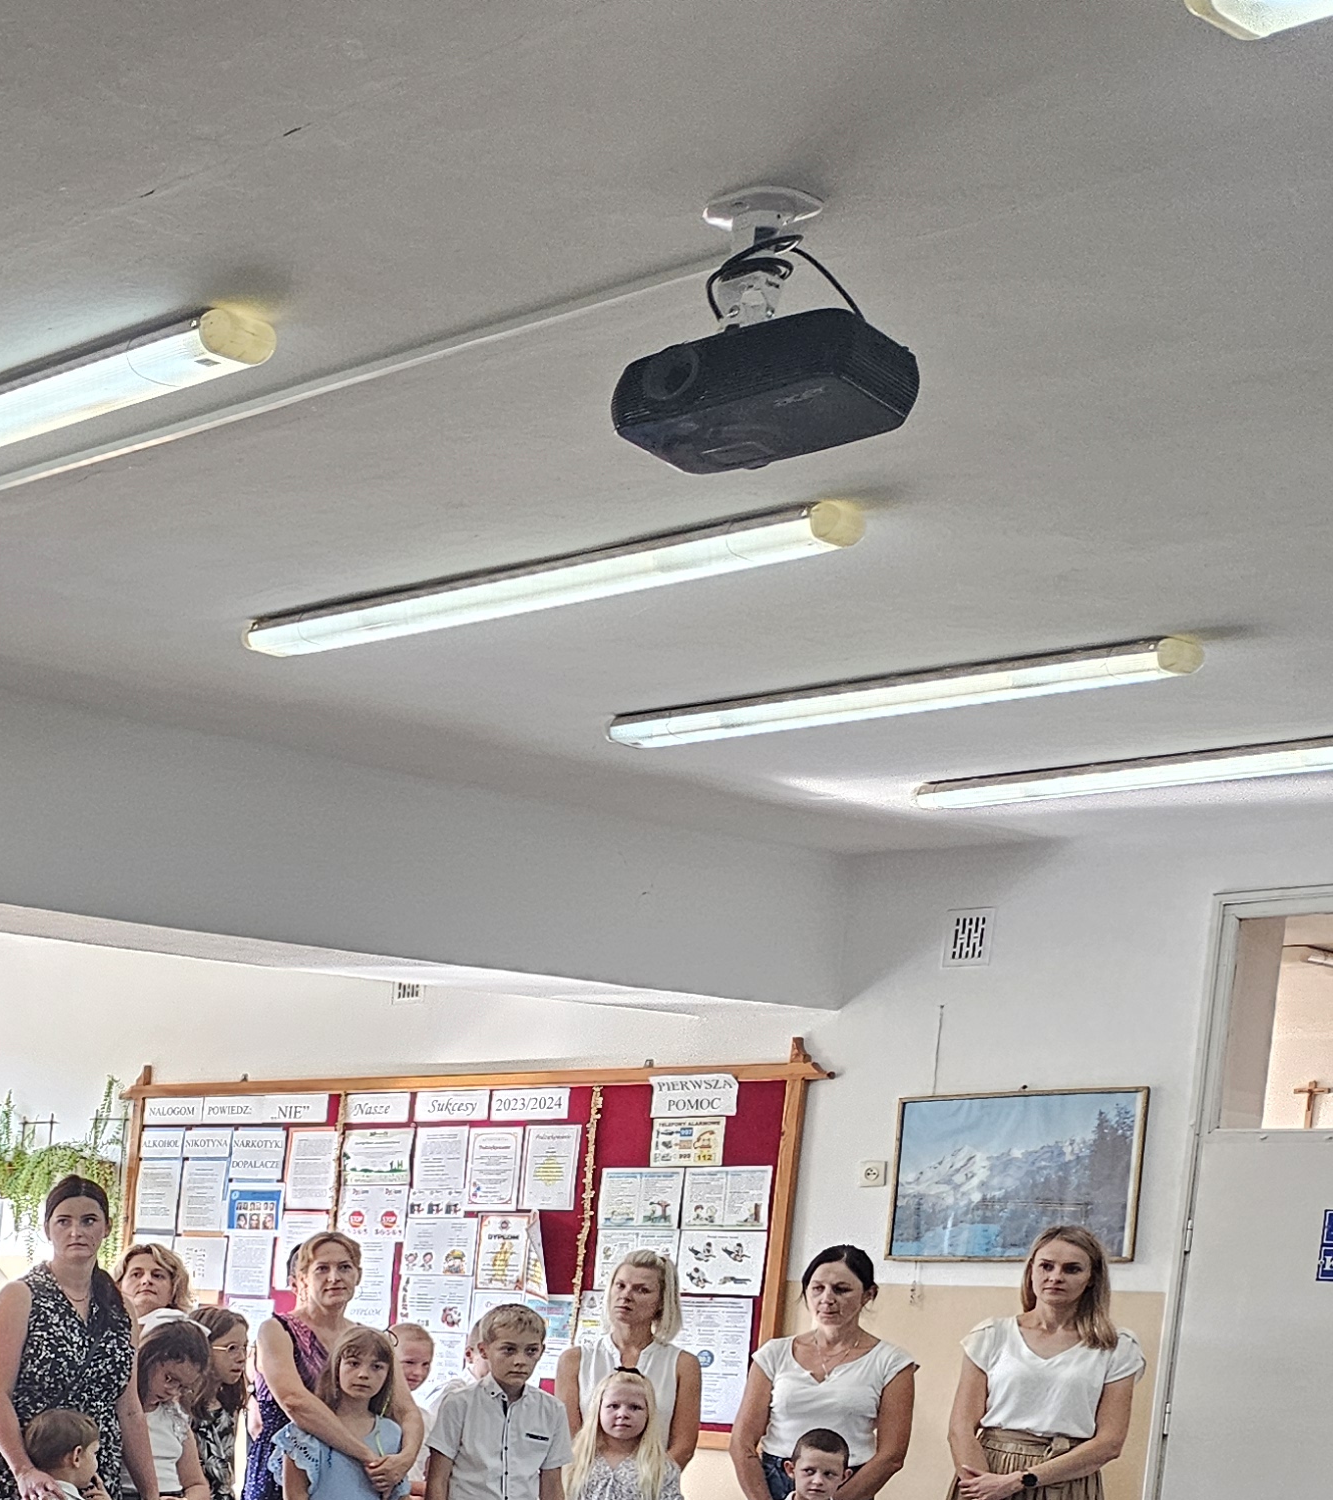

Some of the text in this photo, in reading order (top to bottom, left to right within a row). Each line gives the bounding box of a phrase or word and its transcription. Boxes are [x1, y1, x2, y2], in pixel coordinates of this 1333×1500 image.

[657, 1079, 732, 1091] PIERWSZA
[353, 1096, 563, 1116] Nasze Sukcesy 2023/2024
[667, 1097, 721, 1111] POMOC
[207, 1106, 252, 1115] POWIEDZ:
[142, 1139, 180, 1148] ALKOHOL
[185, 1138, 228, 1148] NIKOTYNA
[233, 1139, 283, 1149] NARKOTYKI
[232, 1160, 279, 1169] DOPALACZE
